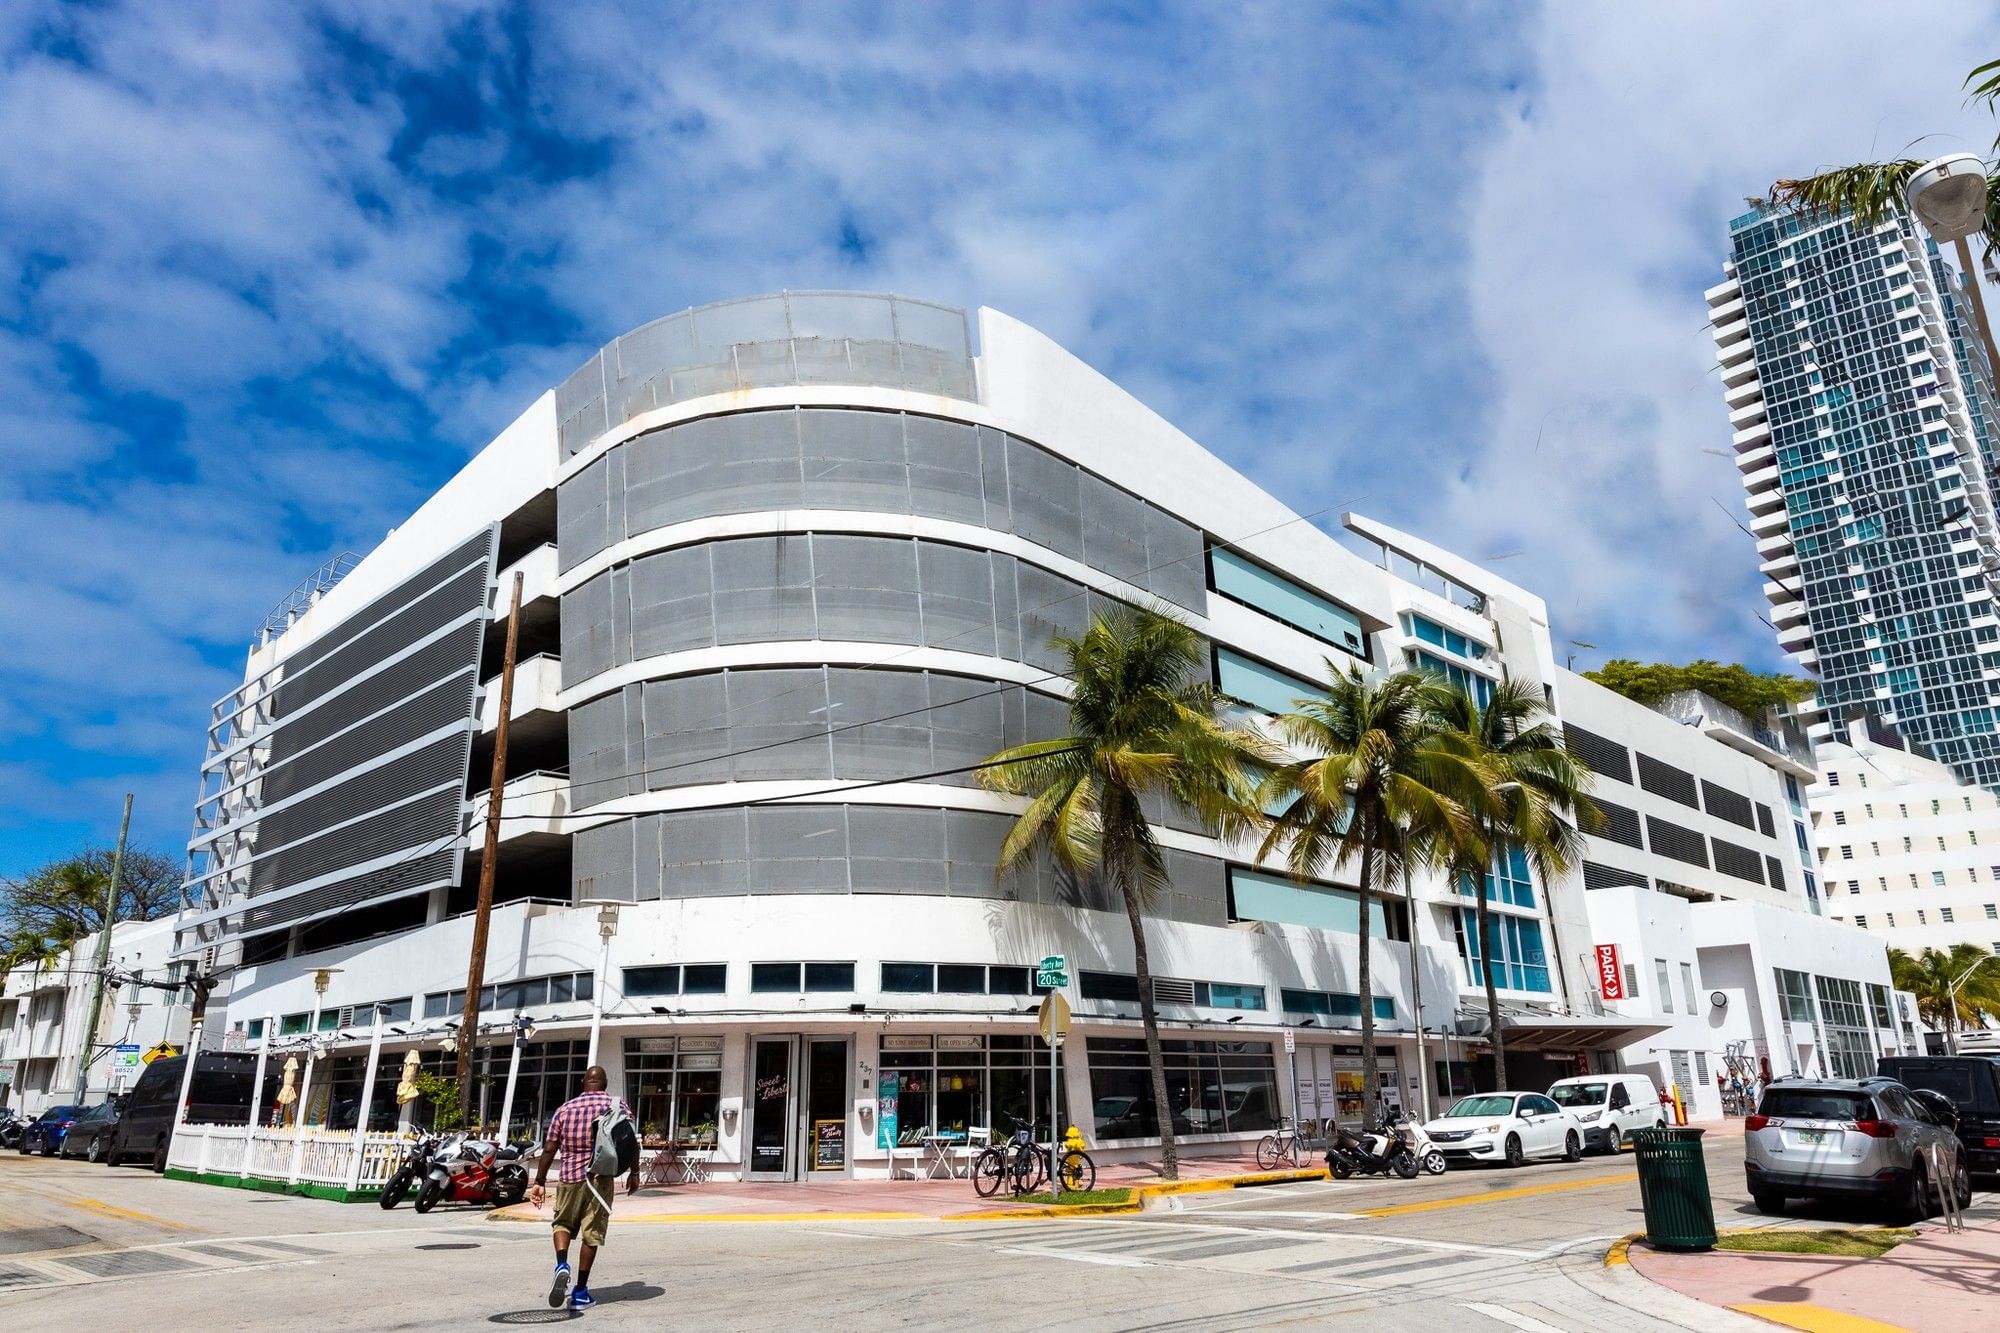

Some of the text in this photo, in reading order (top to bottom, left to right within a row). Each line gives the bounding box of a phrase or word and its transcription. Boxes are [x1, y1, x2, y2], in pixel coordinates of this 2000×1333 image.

[1600, 946, 1618, 984] PARK
[1040, 974, 1052, 985] 20
[860, 1061, 872, 1076] 237
[756, 1074, 780, 1091] Sweet
[762, 1083, 789, 1100] Libert
